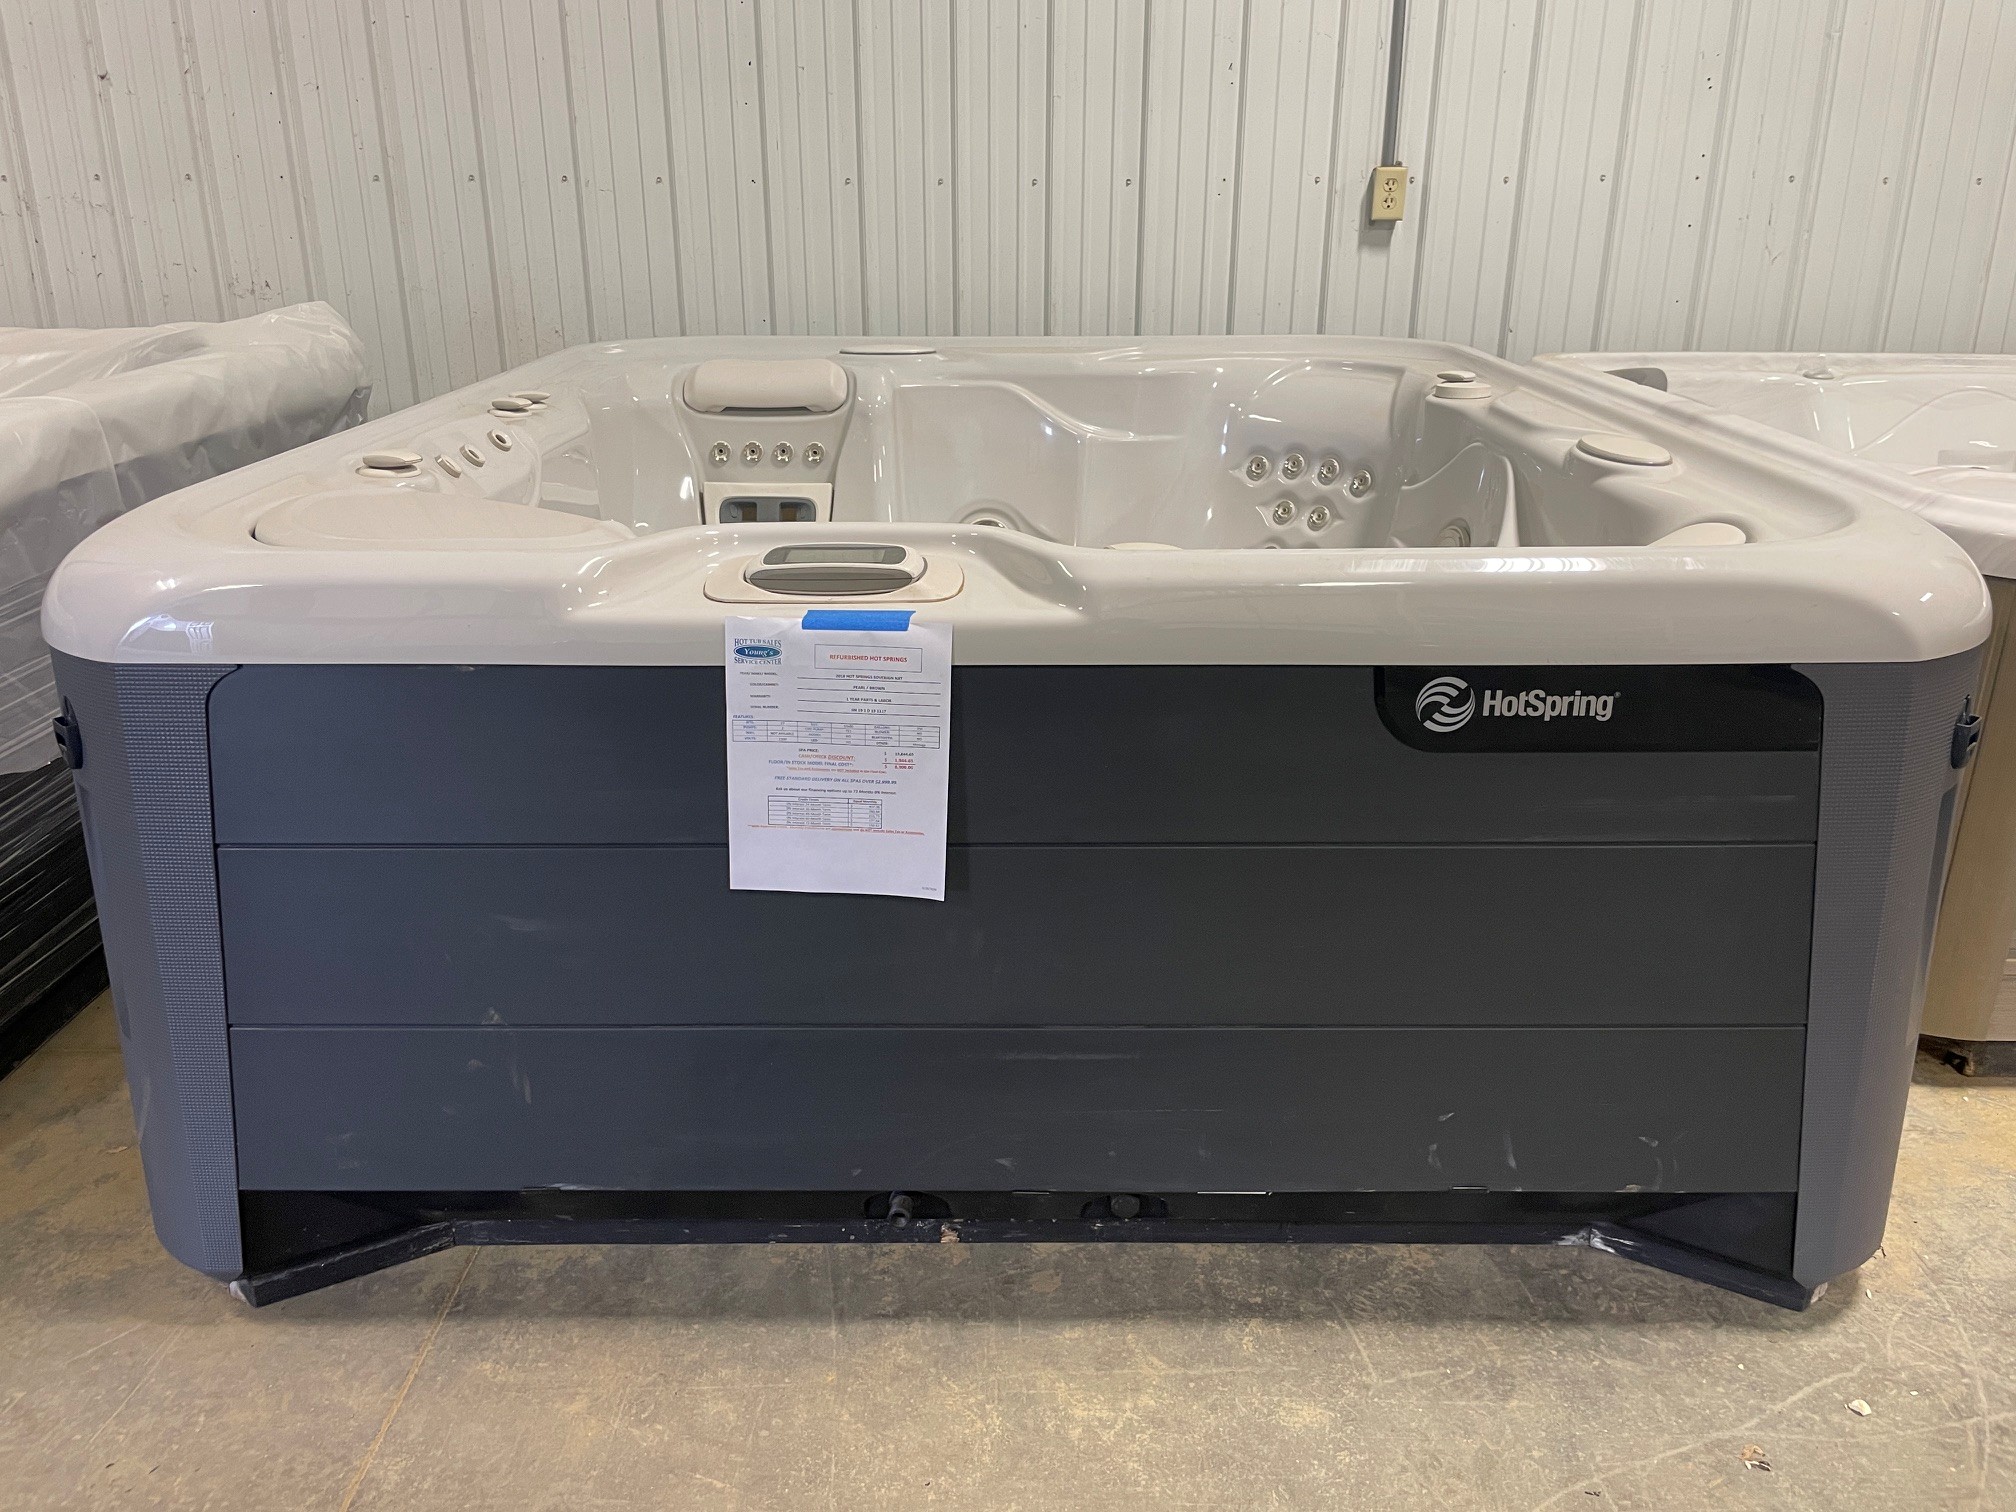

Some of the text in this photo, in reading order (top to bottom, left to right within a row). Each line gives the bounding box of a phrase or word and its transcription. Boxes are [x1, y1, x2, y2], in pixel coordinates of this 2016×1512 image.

[734, 638, 748, 646] HOT
[763, 639, 782, 647] SALES
[744, 648, 774, 657] Young's
[734, 656, 758, 664] SERVICE
[1482, 689, 1614, 722] HotSpring
